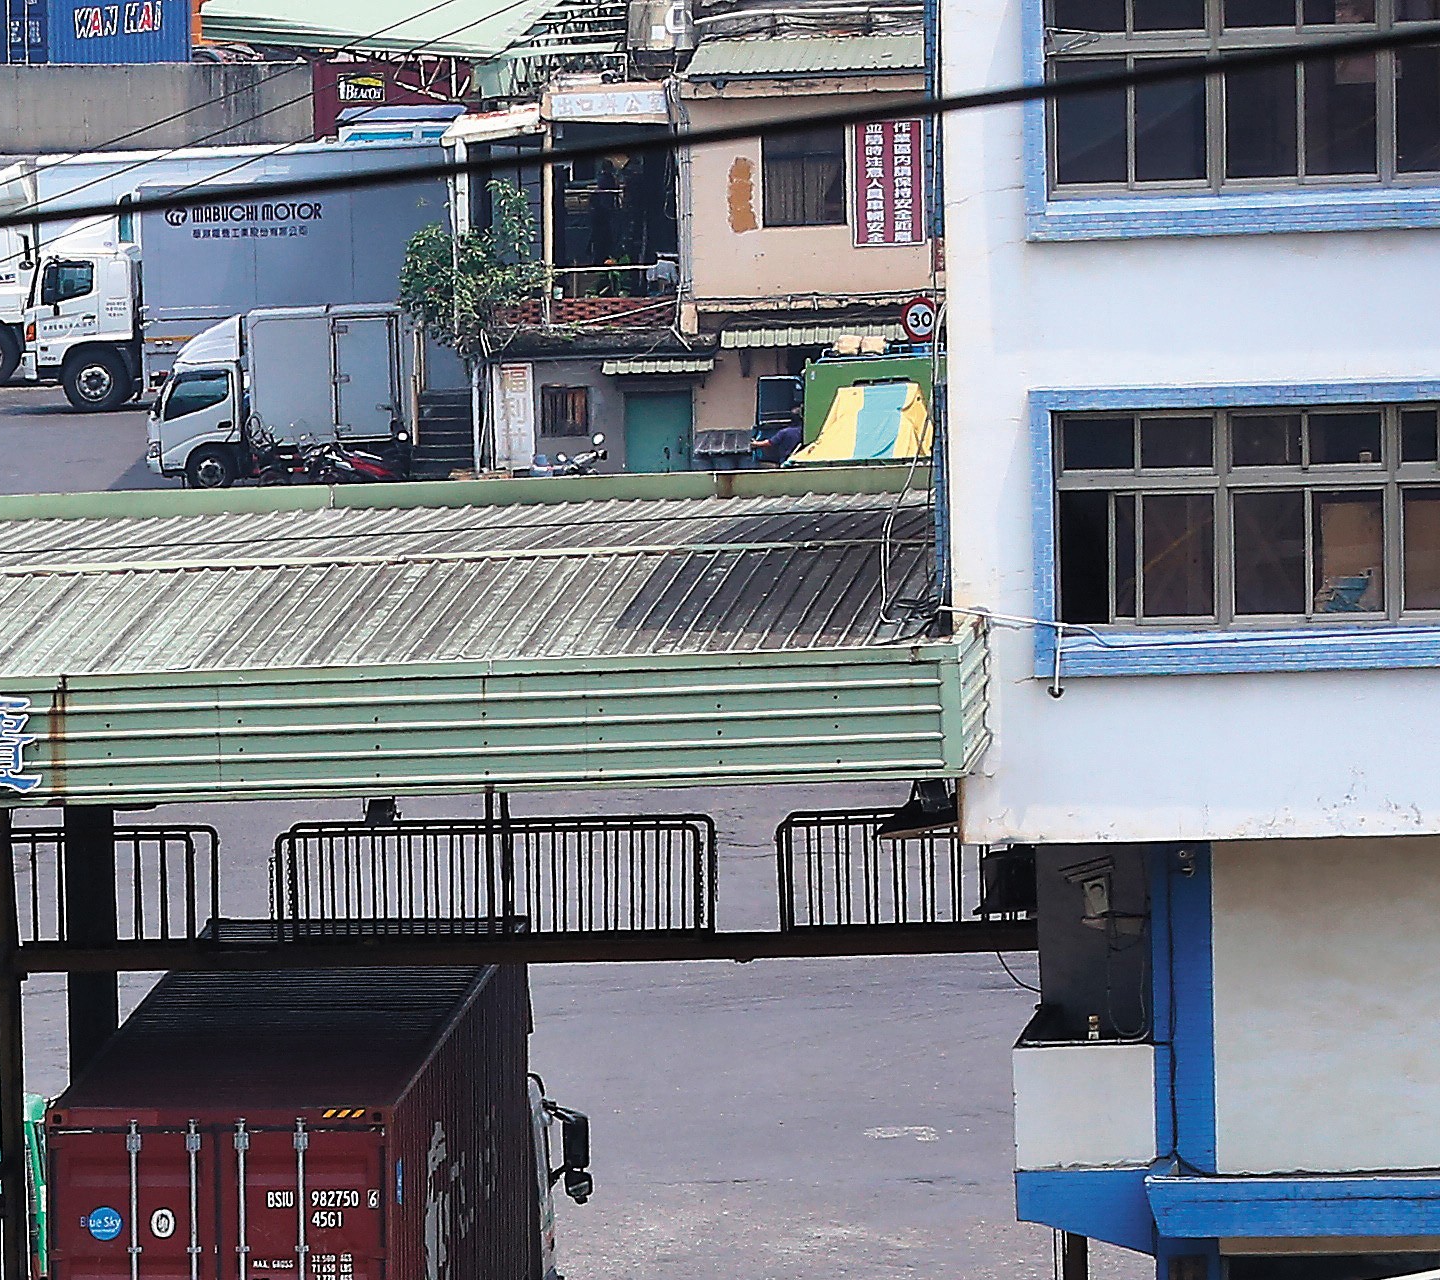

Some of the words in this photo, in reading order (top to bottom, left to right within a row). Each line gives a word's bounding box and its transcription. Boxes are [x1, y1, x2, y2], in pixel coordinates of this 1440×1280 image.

[75, 6, 118, 38] WAN
[192, 205, 258, 222] MABUCHI
[262, 203, 322, 220] MOTOR
[910, 313, 932, 328] 30
[267, 1191, 294, 1208] BSIU
[311, 1190, 359, 1207] 982750
[368, 1190, 378, 1208] 6
[102, 1216, 121, 1232] Sky
[312, 1212, 342, 1227] 45G1
